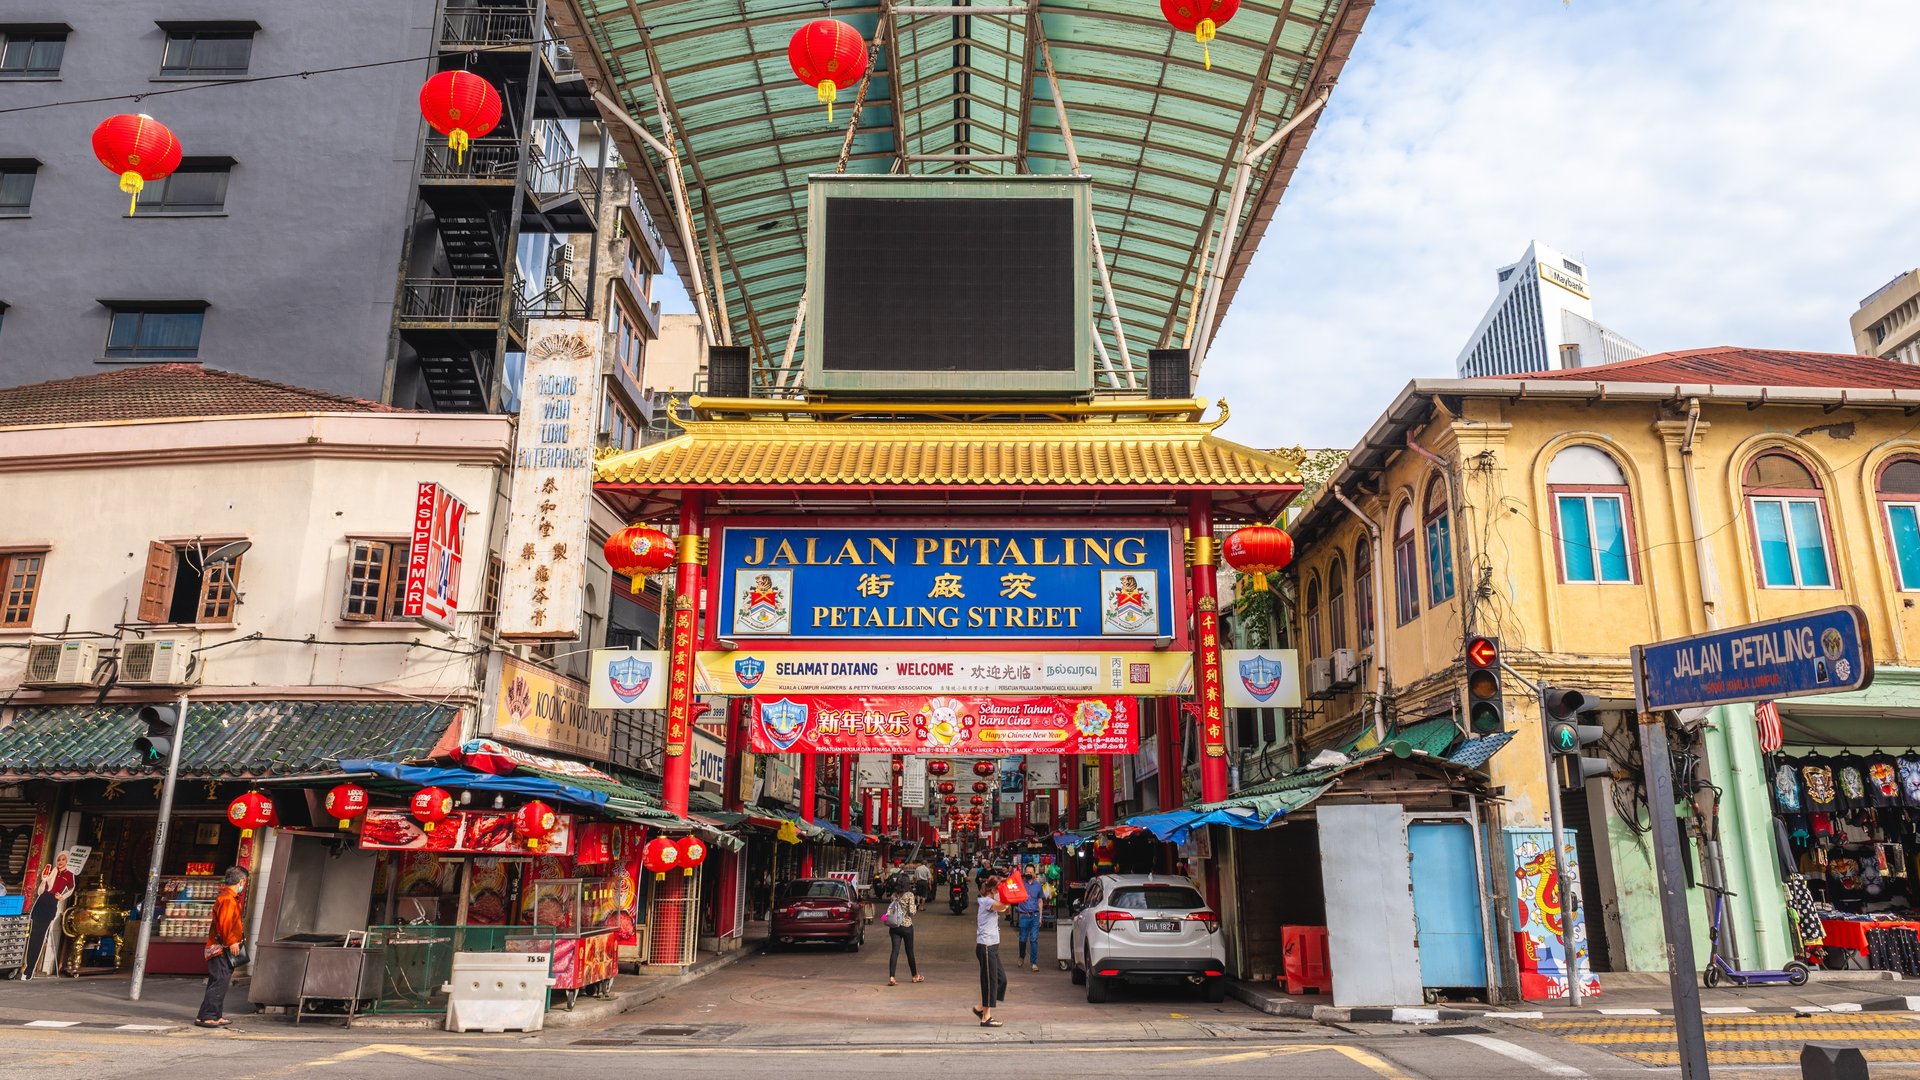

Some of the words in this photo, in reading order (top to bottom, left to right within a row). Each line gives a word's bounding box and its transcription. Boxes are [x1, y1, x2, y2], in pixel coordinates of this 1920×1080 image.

[1554, 272, 1584, 293] Maybank
[517, 448, 587, 469] ENTERPRISE
[434, 488, 465, 555] KK
[744, 537, 898, 566] JALAN
[912, 537, 1148, 566] PETALING
[438, 550, 450, 600] 24
[811, 606, 960, 629] PETALING
[968, 606, 1082, 629] STREET
[1673, 642, 1722, 679] JALAN
[1731, 626, 1816, 670] PETALING
[776, 662, 828, 676] SELAMAT
[831, 662, 878, 676] DATANG
[896, 662, 954, 676] WELCOME
[970, 664, 1032, 680] 欢迎光临
[1046, 664, 1098, 677] நல்வரவு
[1111, 657, 1122, 688] 丙申年
[1727, 677, 1749, 691] KUALA
[1751, 673, 1779, 689] LUMPUR
[535, 691, 567, 725] KOONG
[569, 702, 589, 730] WOH
[589, 710, 610, 737] TONG
[713, 708, 725, 716] 3999
[979, 703, 1020, 714] Selamat
[1023, 703, 1053, 714] Tahun
[816, 709, 911, 736] 新年快乐
[979, 715, 1005, 725] Baru
[1007, 715, 1031, 725] Cina
[986, 731, 1006, 740] Happy
[1007, 731, 1031, 739] Chinese
[1033, 731, 1047, 739] New
[1048, 731, 1062, 739] Year
[700, 749, 725, 783] HOTE
[1160, 923, 1175, 931] 1827
